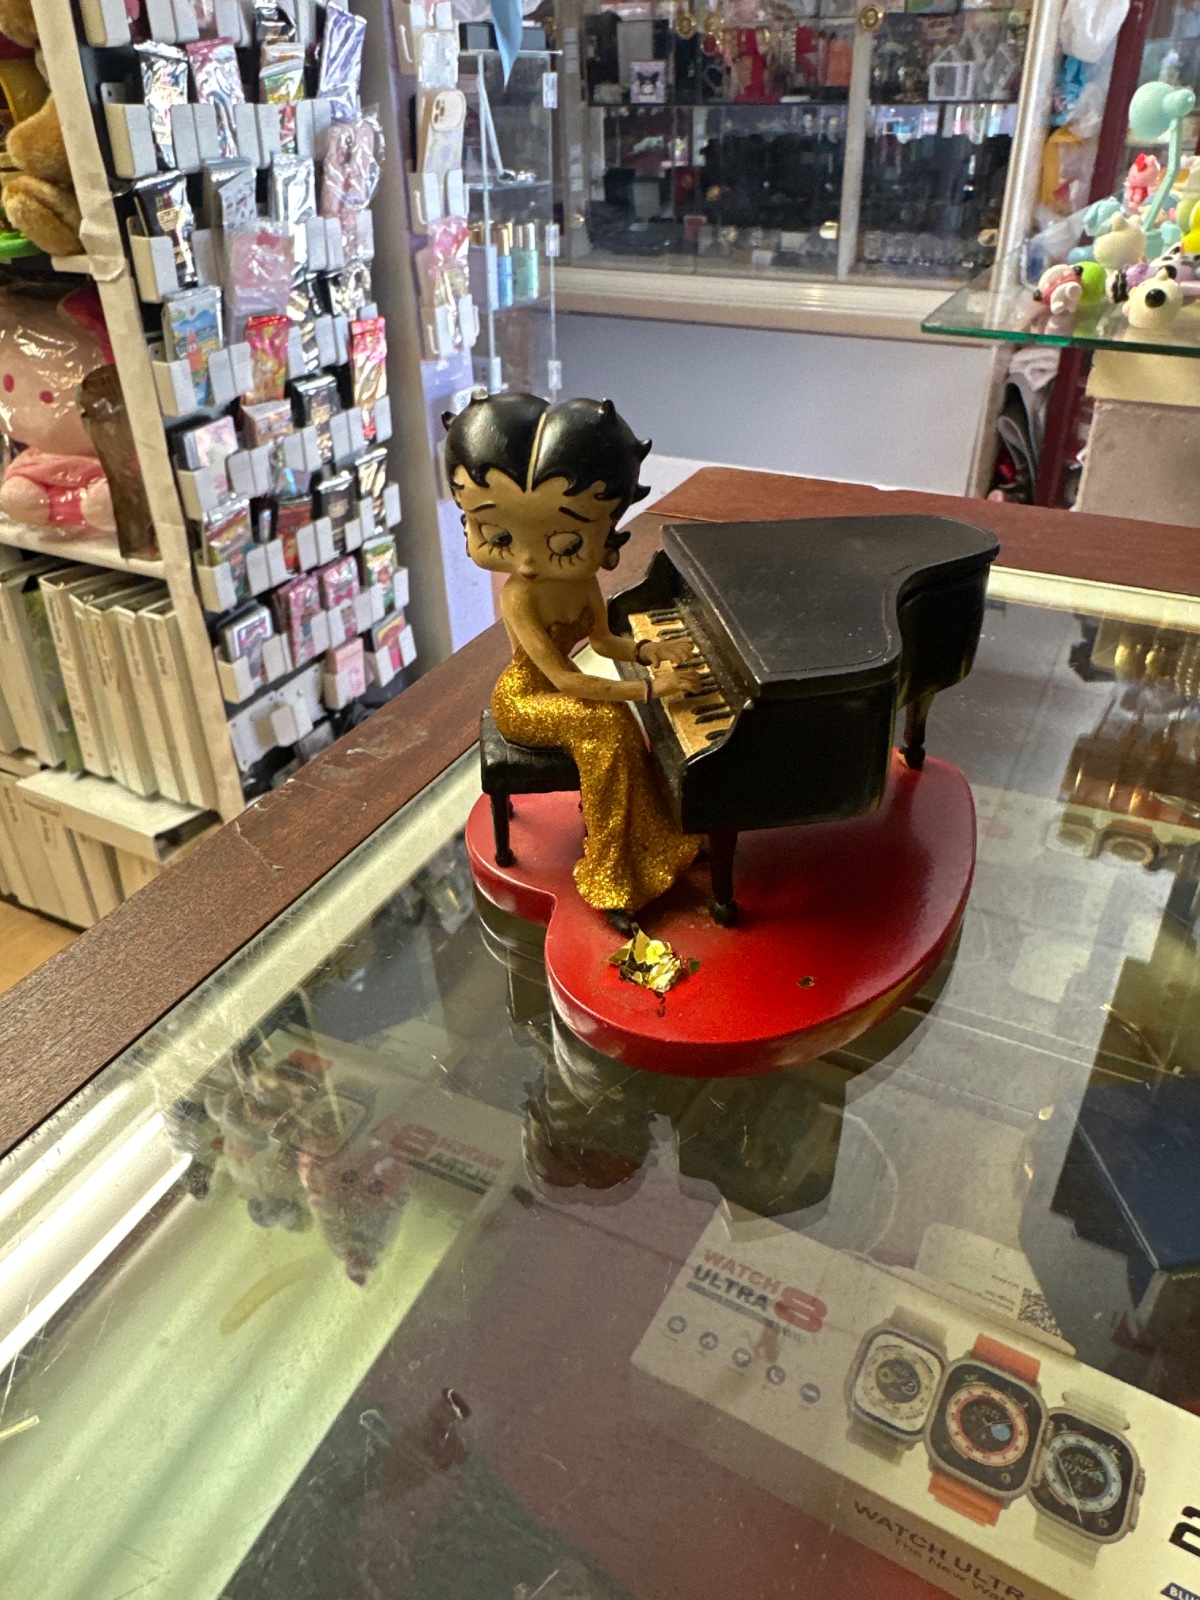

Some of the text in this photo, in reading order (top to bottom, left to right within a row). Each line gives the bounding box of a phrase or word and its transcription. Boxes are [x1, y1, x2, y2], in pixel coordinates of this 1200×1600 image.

[693, 1264, 769, 1311] ULTRA
[704, 1249, 782, 1294] WATCH
[774, 1286, 828, 1333] 8
[854, 1501, 1026, 1600] WATCH ULTR
[896, 1537, 1005, 1600] The New Wa
[1169, 1586, 1200, 1600] BLU
